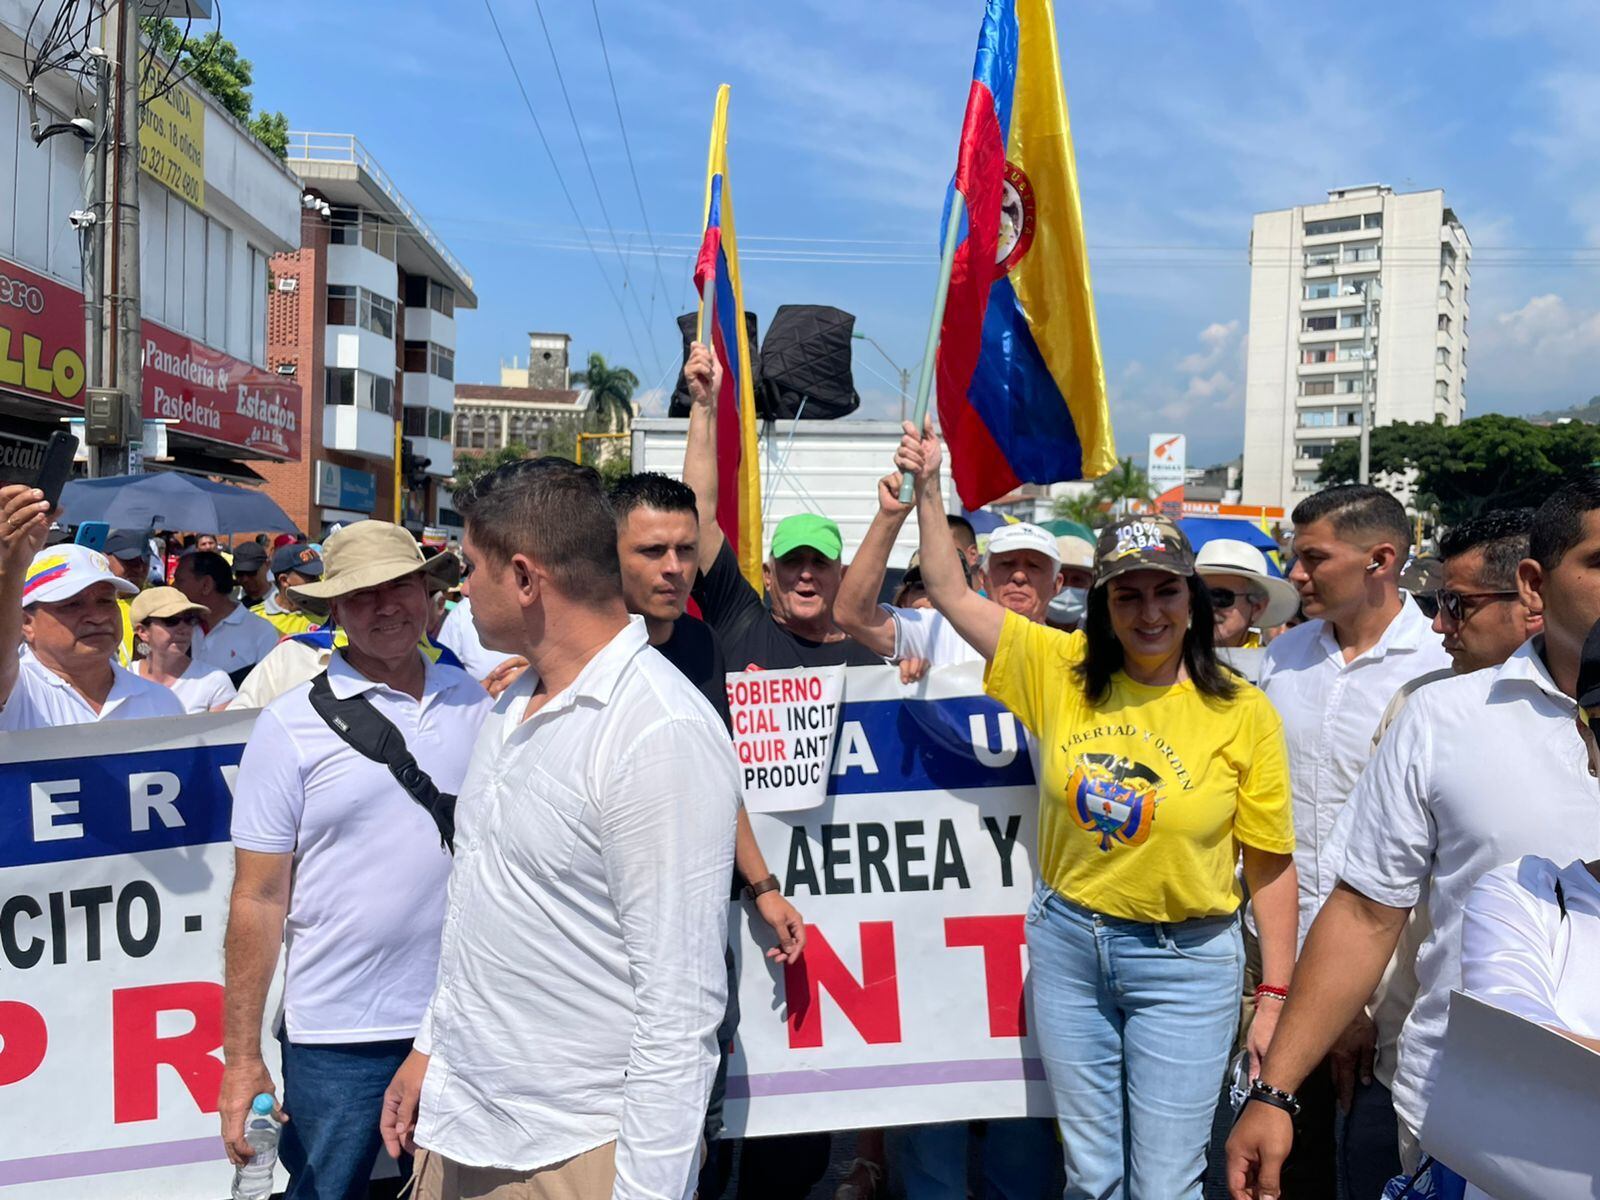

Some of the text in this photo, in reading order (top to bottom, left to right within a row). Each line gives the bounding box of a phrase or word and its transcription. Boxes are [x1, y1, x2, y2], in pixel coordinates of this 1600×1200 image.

[169, 121, 178, 148] 18
[149, 146, 165, 177] 321
[168, 158, 181, 189] 772
[0, 325, 86, 399] LLO
[145, 339, 229, 393] Panadería &
[153, 385, 221, 430] Pastelería
[235, 383, 296, 432] Estación
[1115, 522, 1161, 541] 100%
[1117, 534, 1166, 554] CABAL
[730, 703, 836, 735] CIAL INCIT
[733, 733, 834, 765] QUIR ANT
[1060, 724, 1138, 754] LIBERTAD
[1154, 738, 1195, 792] ORDEN
[744, 760, 825, 790] PRODUC
[784, 815, 1022, 896] AEREA Y
[0, 879, 162, 969] CITO
